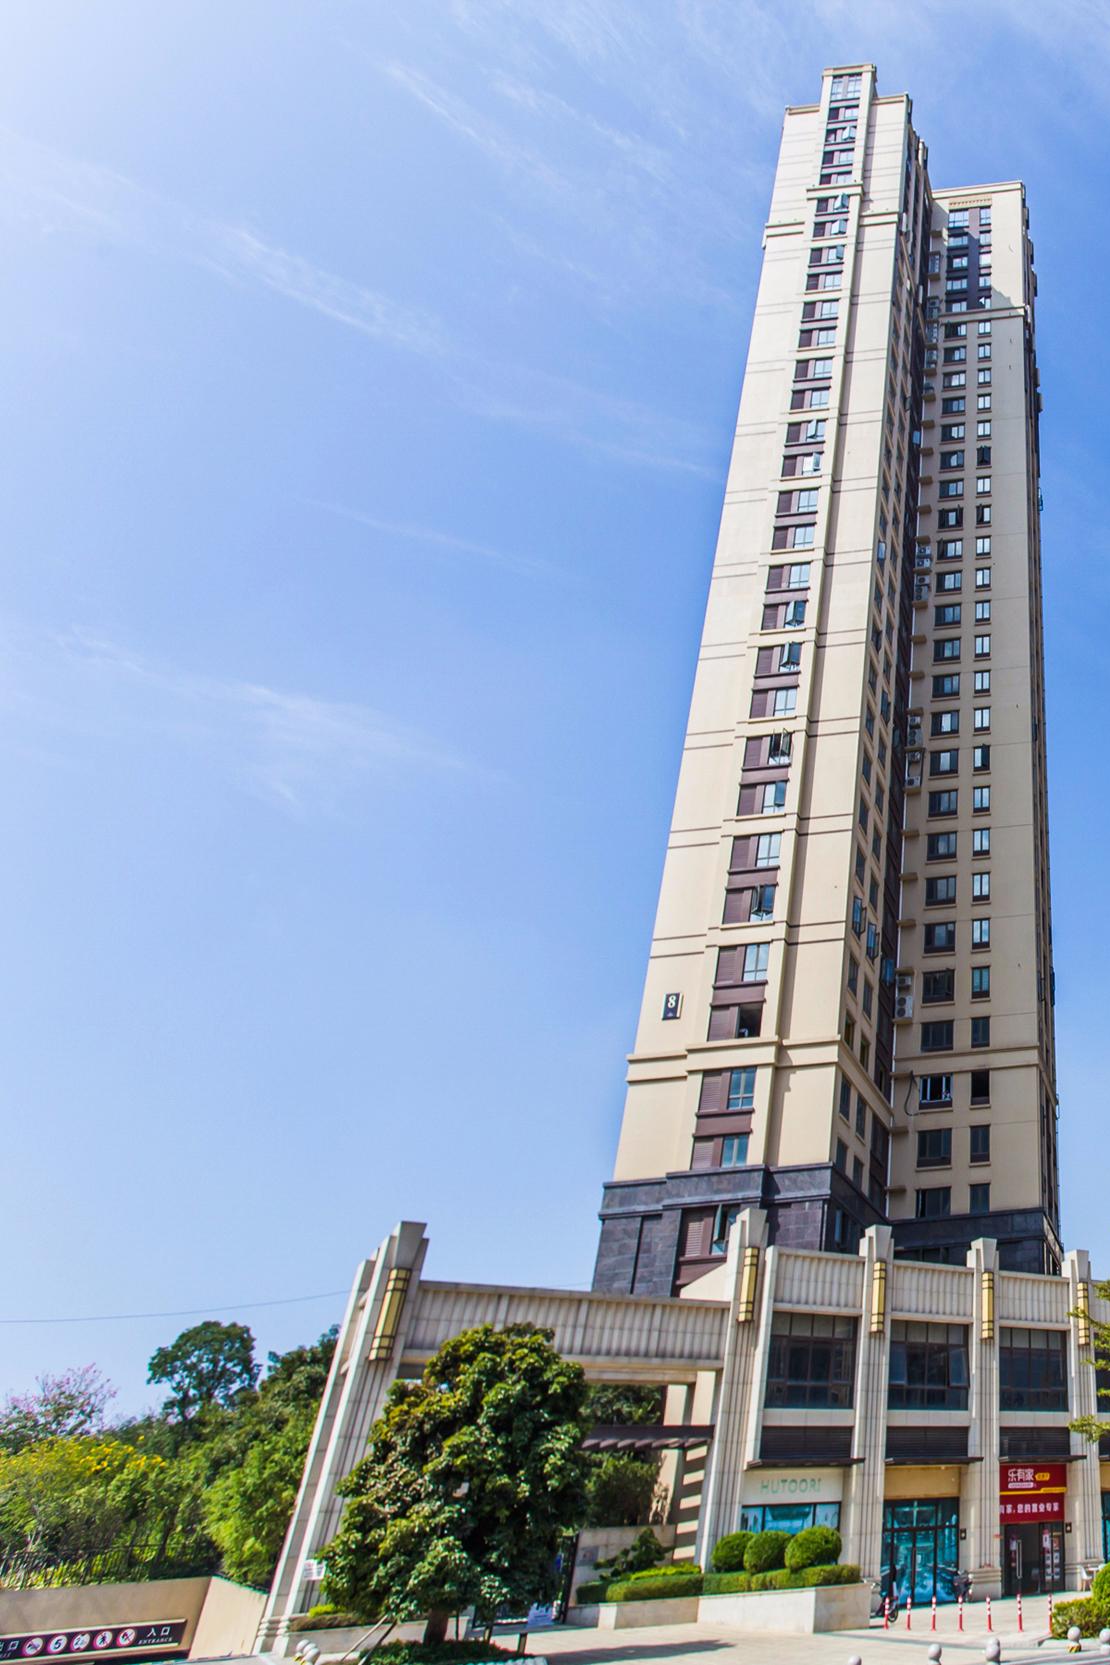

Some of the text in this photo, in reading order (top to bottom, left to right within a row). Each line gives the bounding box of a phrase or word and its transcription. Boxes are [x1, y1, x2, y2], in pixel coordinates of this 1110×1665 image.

[668, 995, 676, 1008] 8
[1008, 1468, 1035, 1482] 乐有家
[147, 1626, 171, 1638] 入口
[54, 1639, 63, 1650] 5
